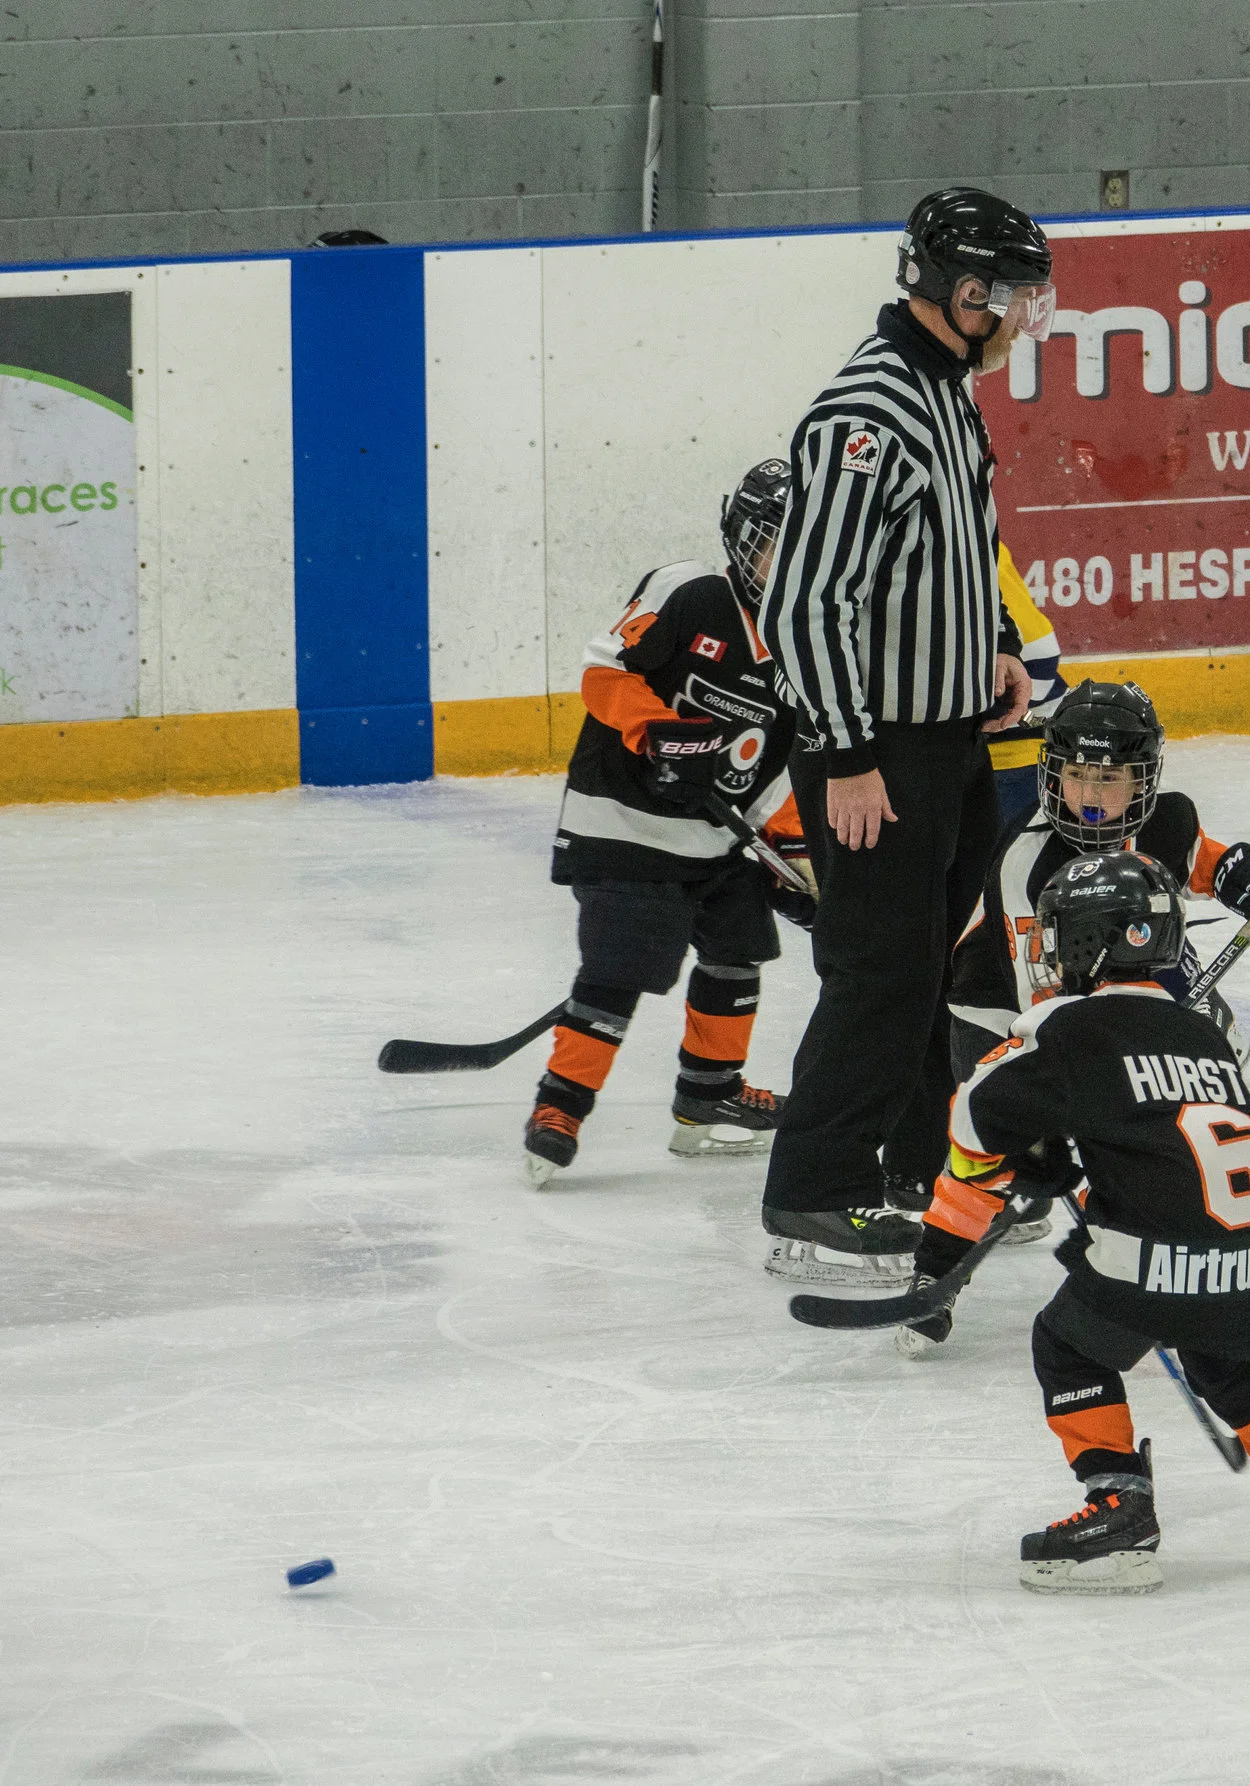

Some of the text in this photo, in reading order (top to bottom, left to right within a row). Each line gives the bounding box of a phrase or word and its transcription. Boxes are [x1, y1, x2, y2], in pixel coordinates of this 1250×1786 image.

[956, 244, 996, 258] BAUER
[843, 462, 874, 471] CANADA
[1026, 555, 1114, 607] 480
[703, 693, 766, 724] ORANGEVILLE
[660, 735, 723, 754] BAUE
[1079, 736, 1110, 748] Reebok
[1070, 884, 1117, 898] BAUER
[1188, 945, 1239, 1000] RIBCOR
[1123, 1055, 1248, 1106] HURST
[1052, 1385, 1103, 1407] BAUER
